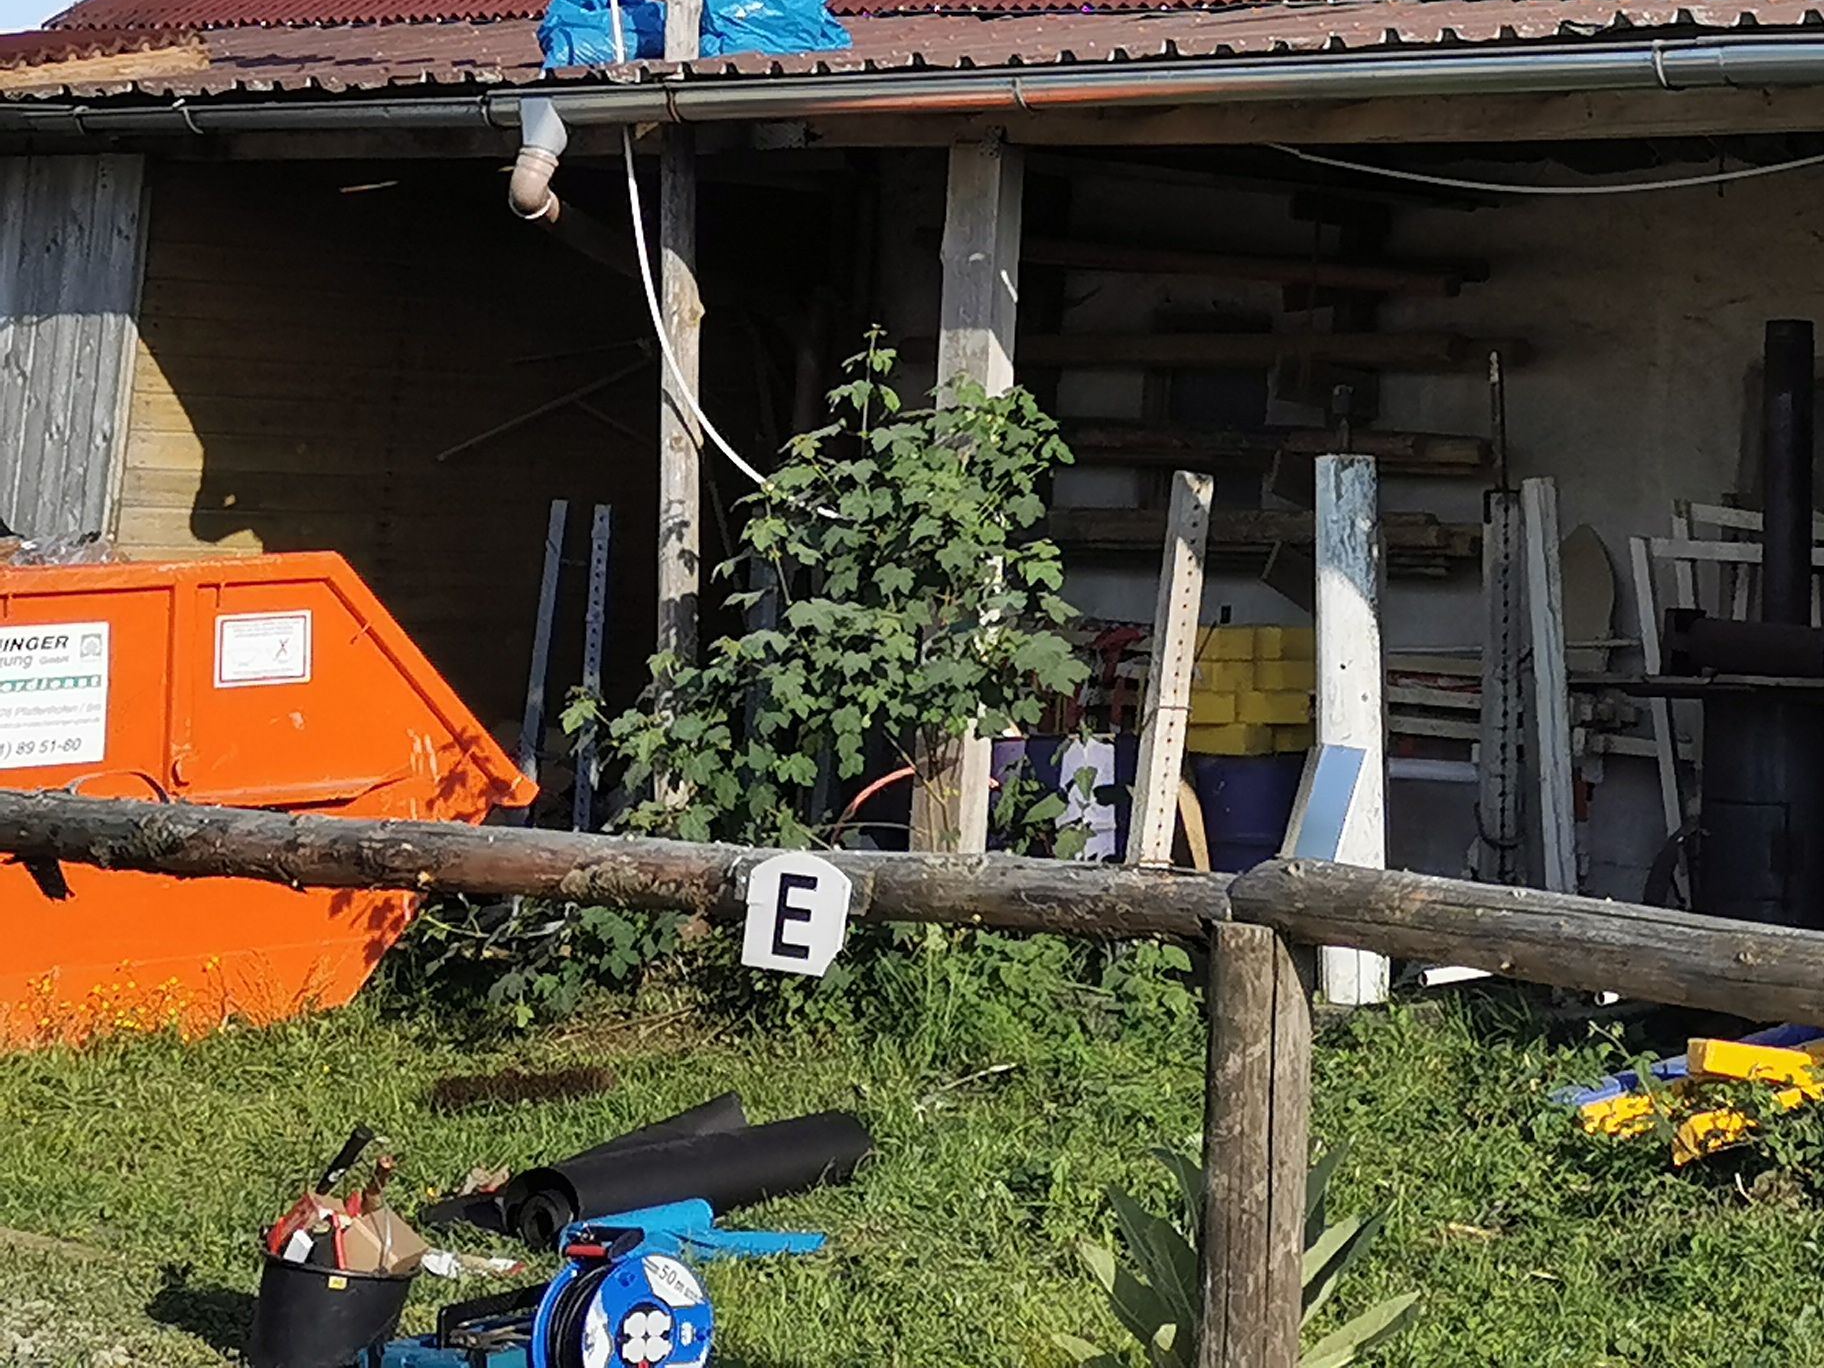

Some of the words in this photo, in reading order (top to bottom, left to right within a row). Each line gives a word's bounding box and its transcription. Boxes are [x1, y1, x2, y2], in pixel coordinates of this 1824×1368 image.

[0, 635, 69, 652] INGER
[772, 872, 818, 960] E
[659, 1264, 678, 1286] 50
